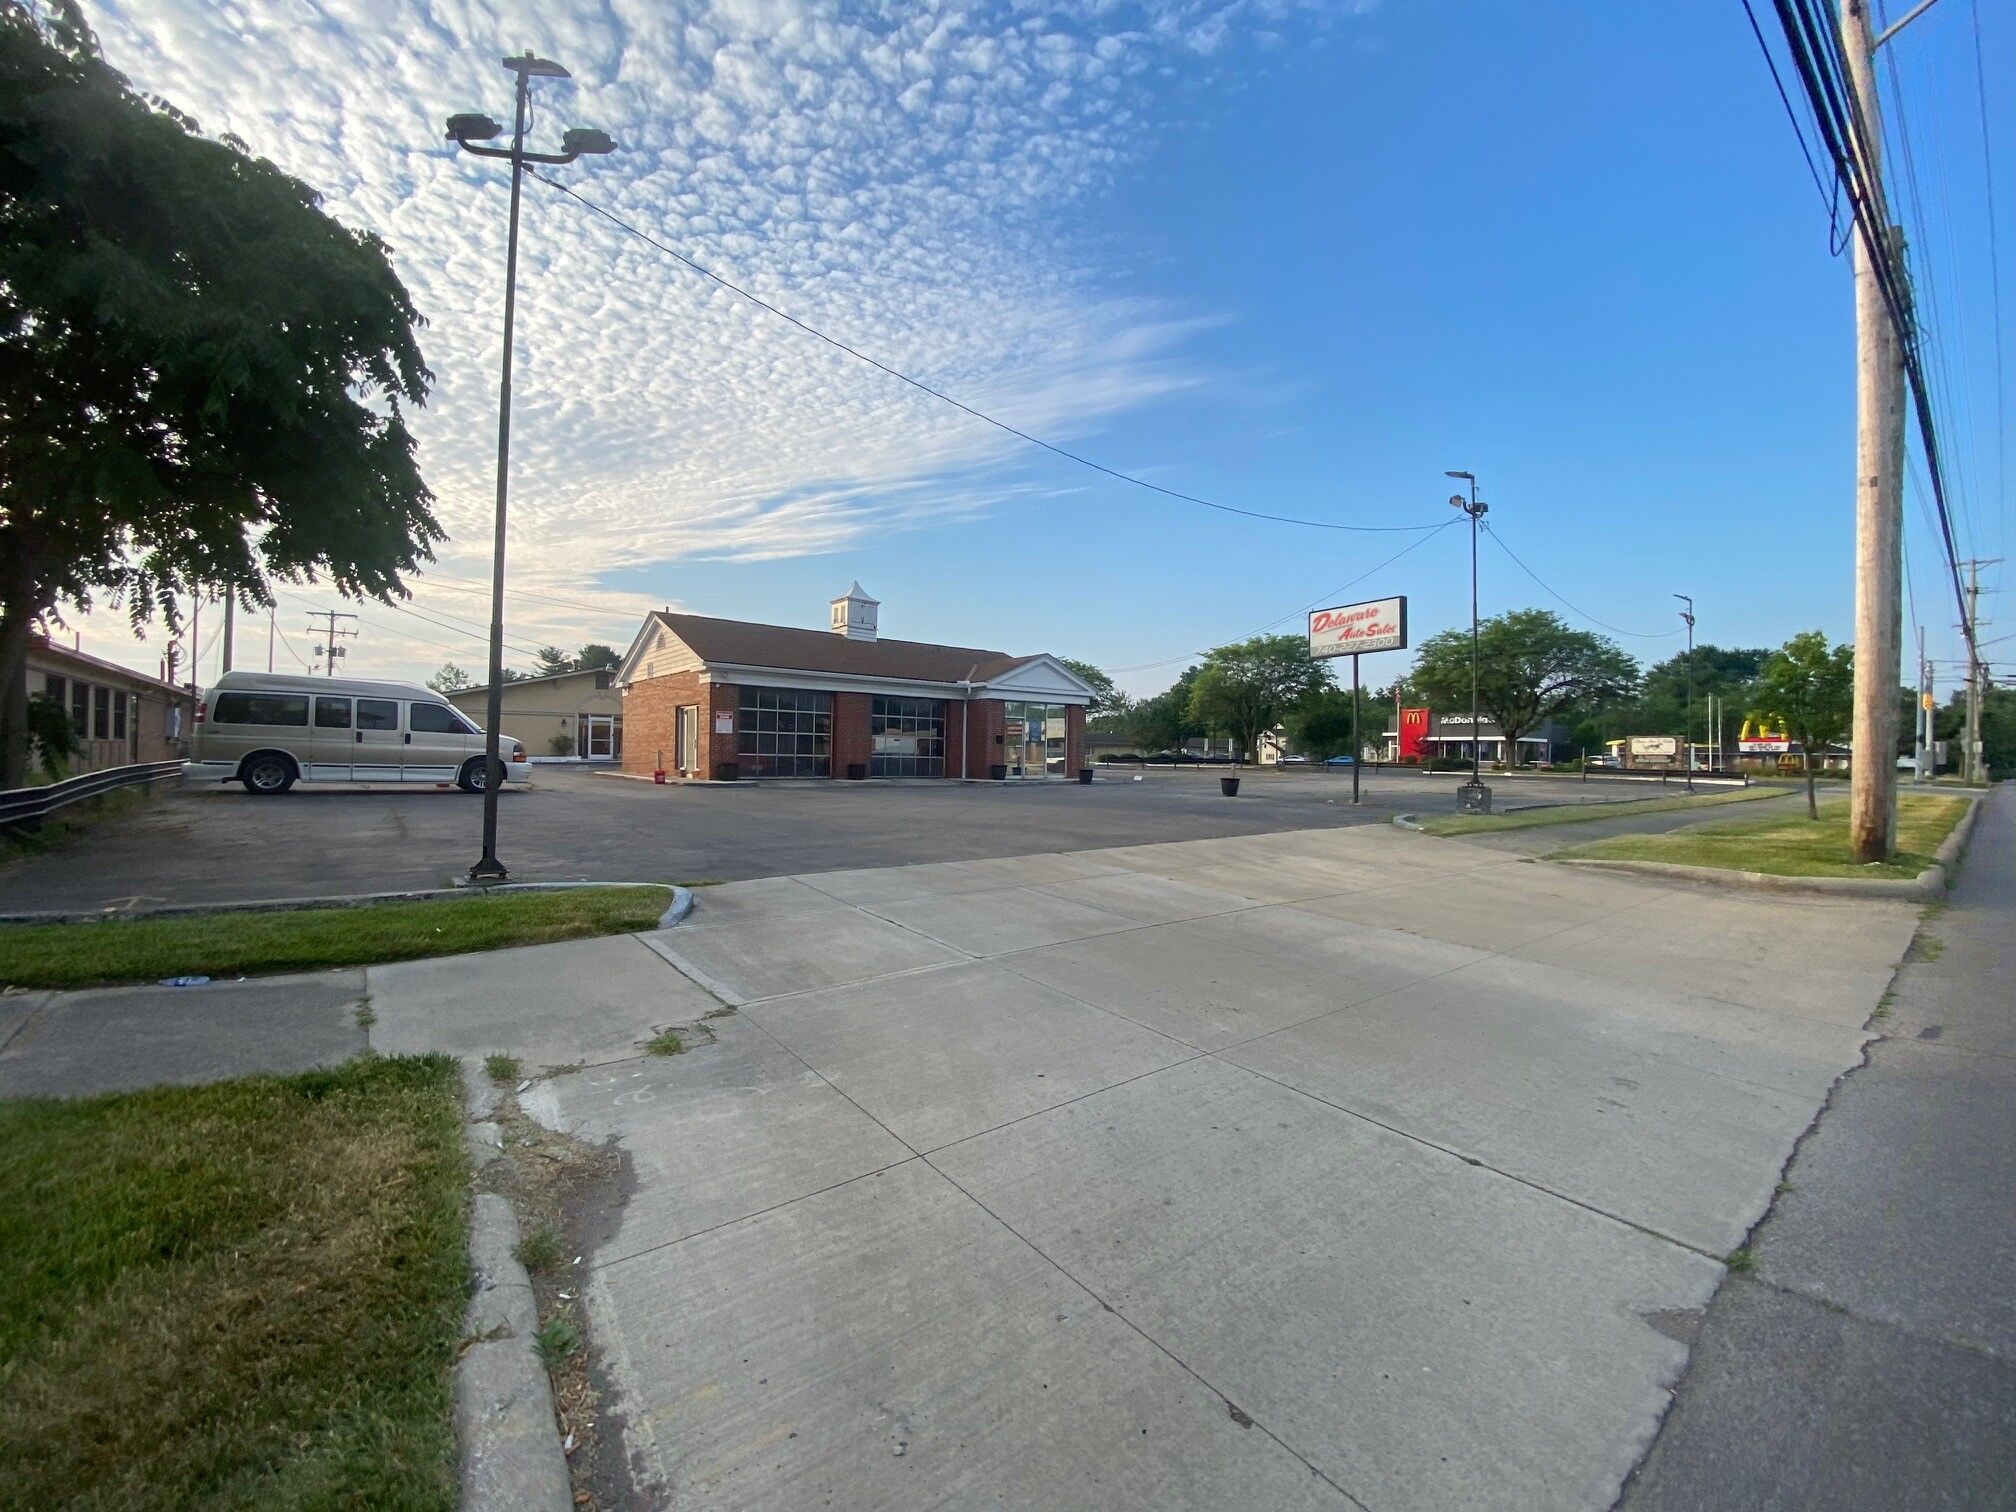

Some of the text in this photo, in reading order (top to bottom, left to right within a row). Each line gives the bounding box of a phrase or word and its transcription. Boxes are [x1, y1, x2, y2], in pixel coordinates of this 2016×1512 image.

[1312, 607, 1379, 633] Delaware
[1339, 623, 1397, 640] Auto Sales
[1315, 637, 1393, 654] 740-227-2300
